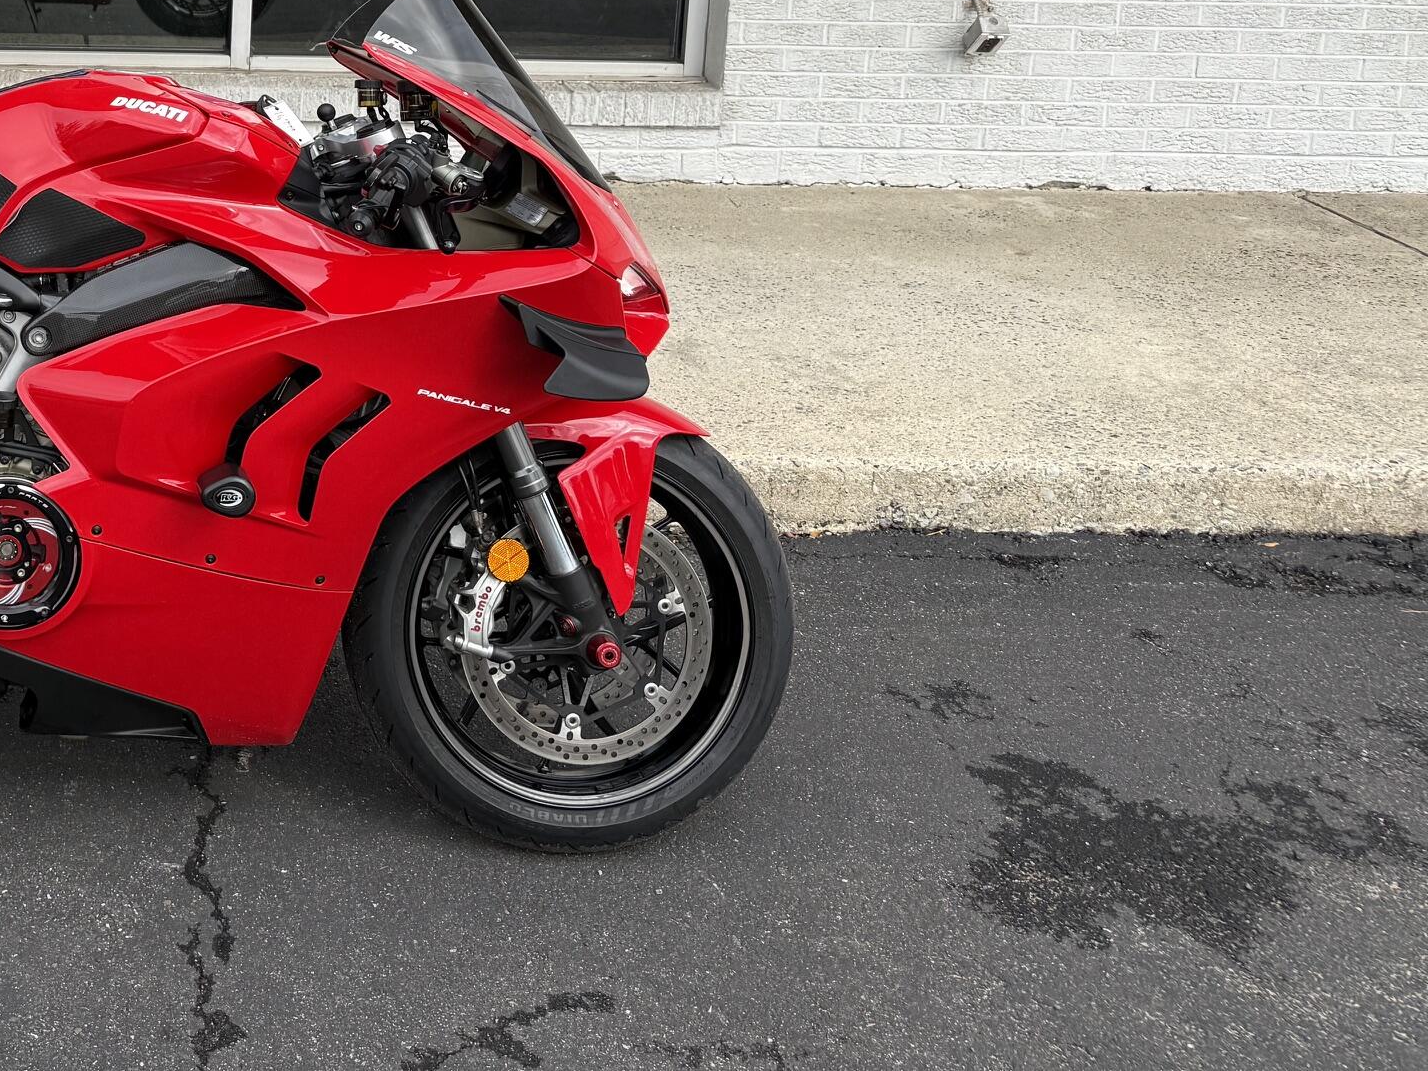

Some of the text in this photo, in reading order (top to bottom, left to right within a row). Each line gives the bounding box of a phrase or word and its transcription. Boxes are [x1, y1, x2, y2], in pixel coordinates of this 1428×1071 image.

[109, 96, 189, 123] DUCATI
[416, 388, 512, 415] PANIGALE V4
[18, 491, 50, 509] PARTS
[470, 585, 493, 633] brembo
